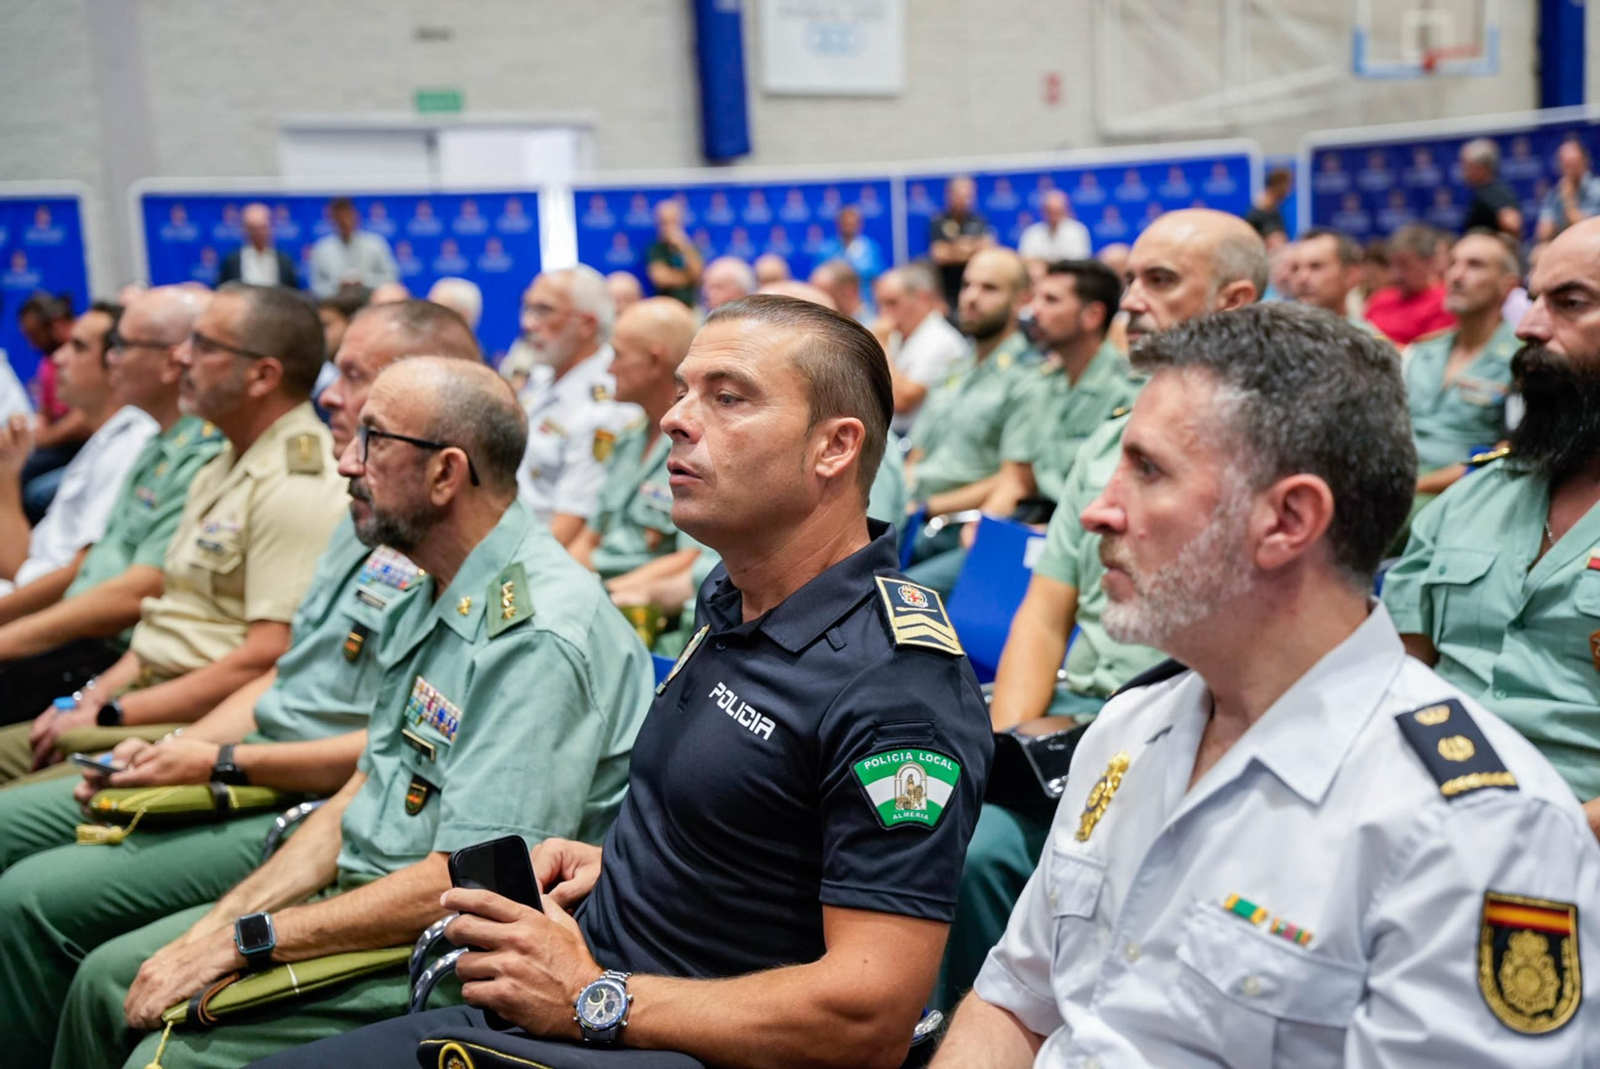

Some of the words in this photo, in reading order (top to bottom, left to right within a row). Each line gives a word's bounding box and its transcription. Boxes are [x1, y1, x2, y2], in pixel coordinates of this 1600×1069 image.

[709, 682, 776, 740] POLICIA
[864, 752, 913, 770] POLICIA
[919, 752, 953, 770] LOCAL
